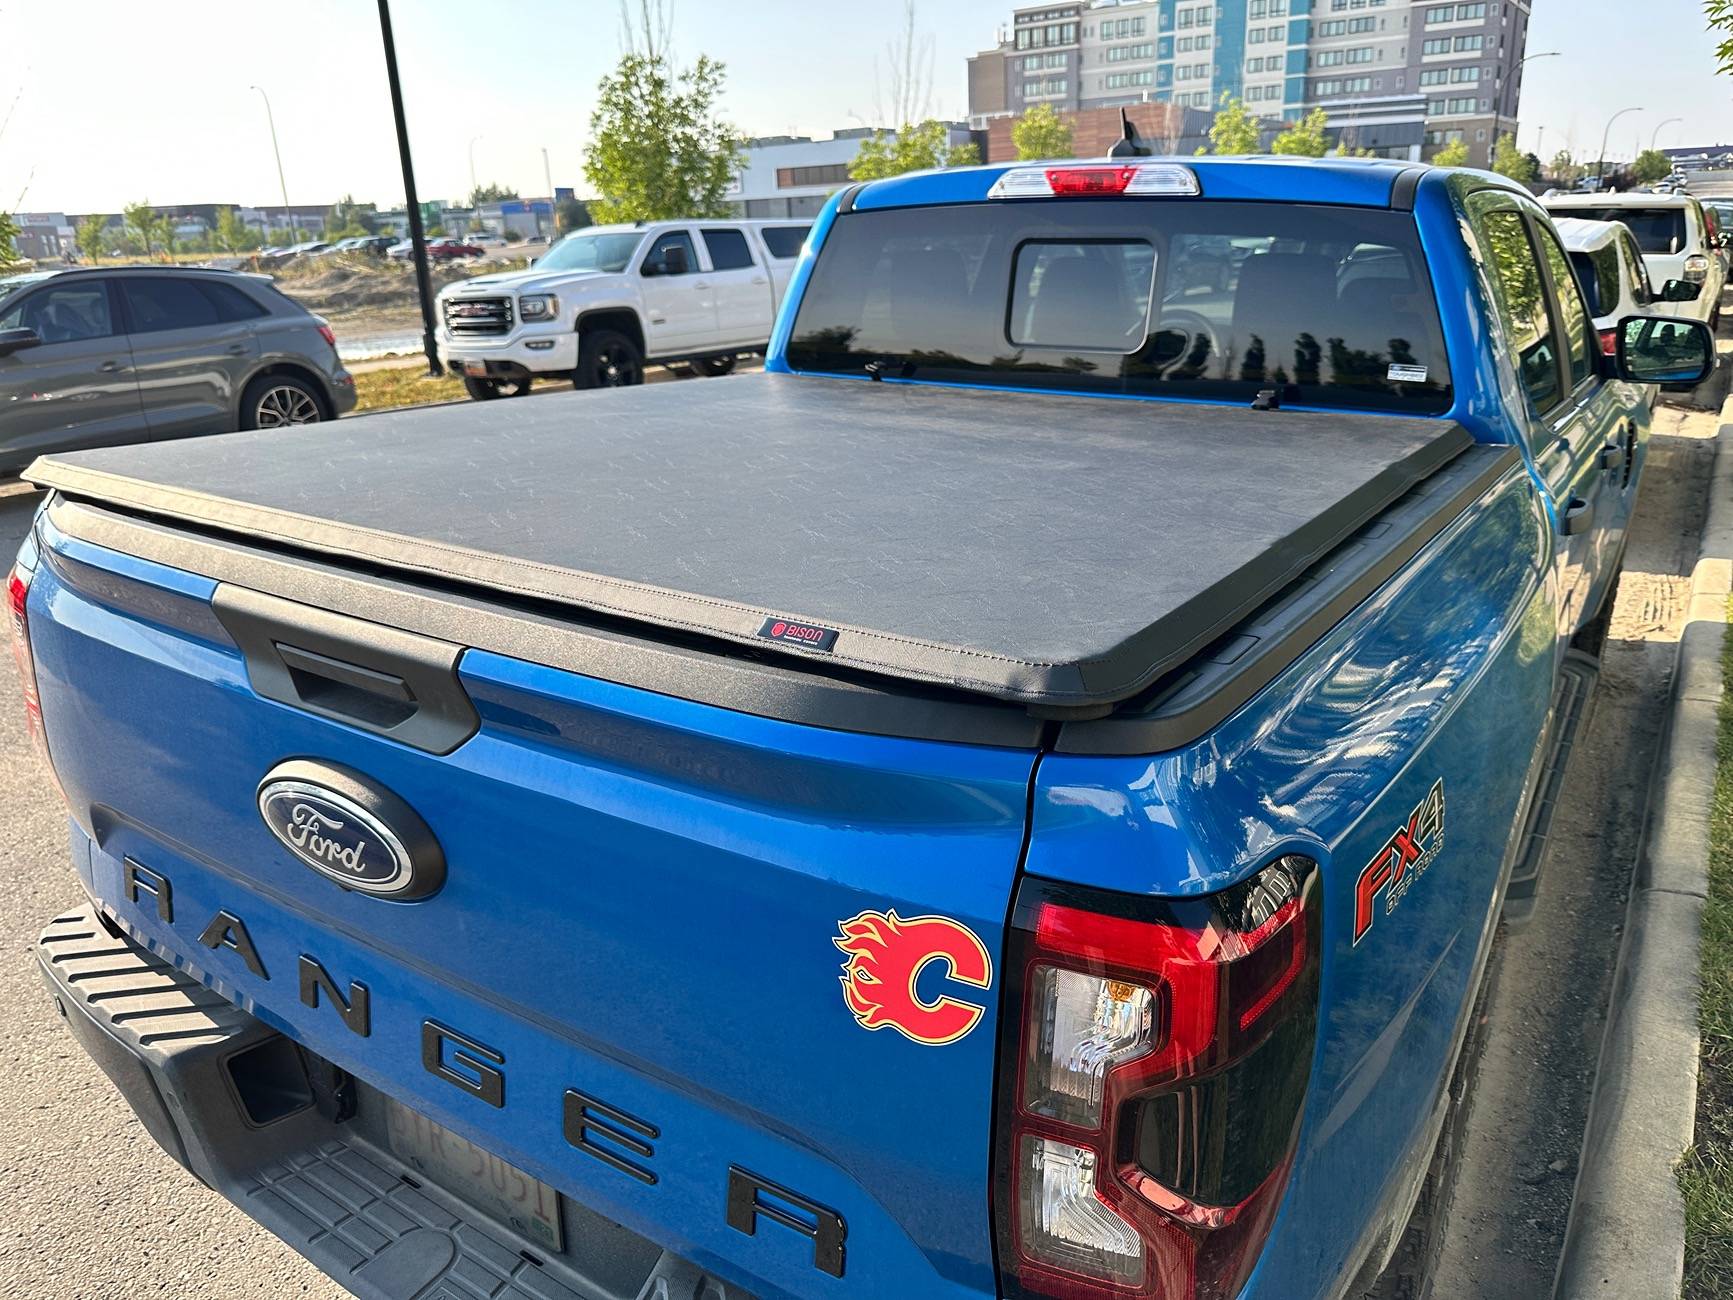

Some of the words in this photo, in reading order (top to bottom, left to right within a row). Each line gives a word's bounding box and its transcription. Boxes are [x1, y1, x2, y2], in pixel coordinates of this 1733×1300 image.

[786, 625, 824, 641] BISON
[287, 803, 366, 873] Ford
[1353, 777, 1444, 947] FX4
[123, 855, 847, 1278] RANGER
